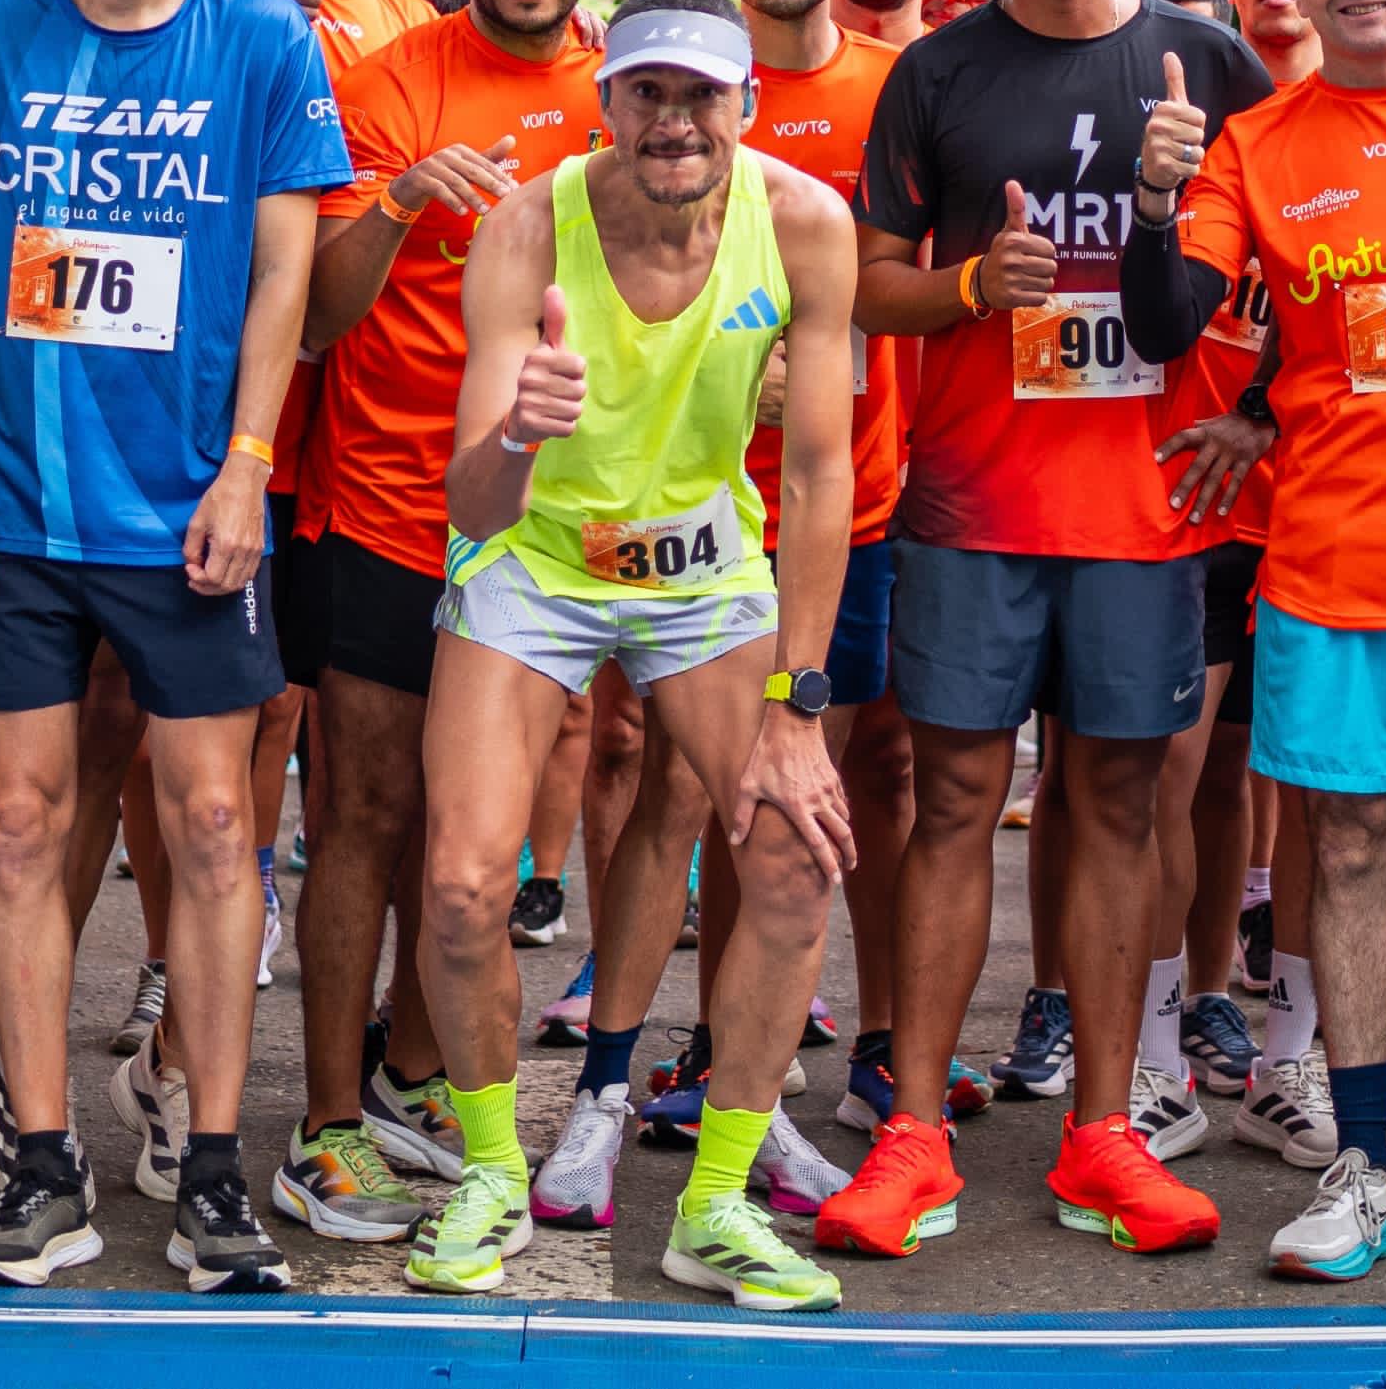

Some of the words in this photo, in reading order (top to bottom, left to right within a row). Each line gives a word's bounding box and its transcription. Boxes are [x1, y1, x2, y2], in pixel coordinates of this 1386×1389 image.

[21, 92, 213, 137] TEAM
[19, 199, 36, 217] el
[47, 205, 98, 224] agua
[109, 204, 131, 222] de
[1282, 189, 1360, 219] Comfenalco
[1073, 251, 1117, 261] RUNNING
[48, 255, 135, 314] 176
[1059, 315, 1125, 369] 90
[616, 521, 719, 580] 304
